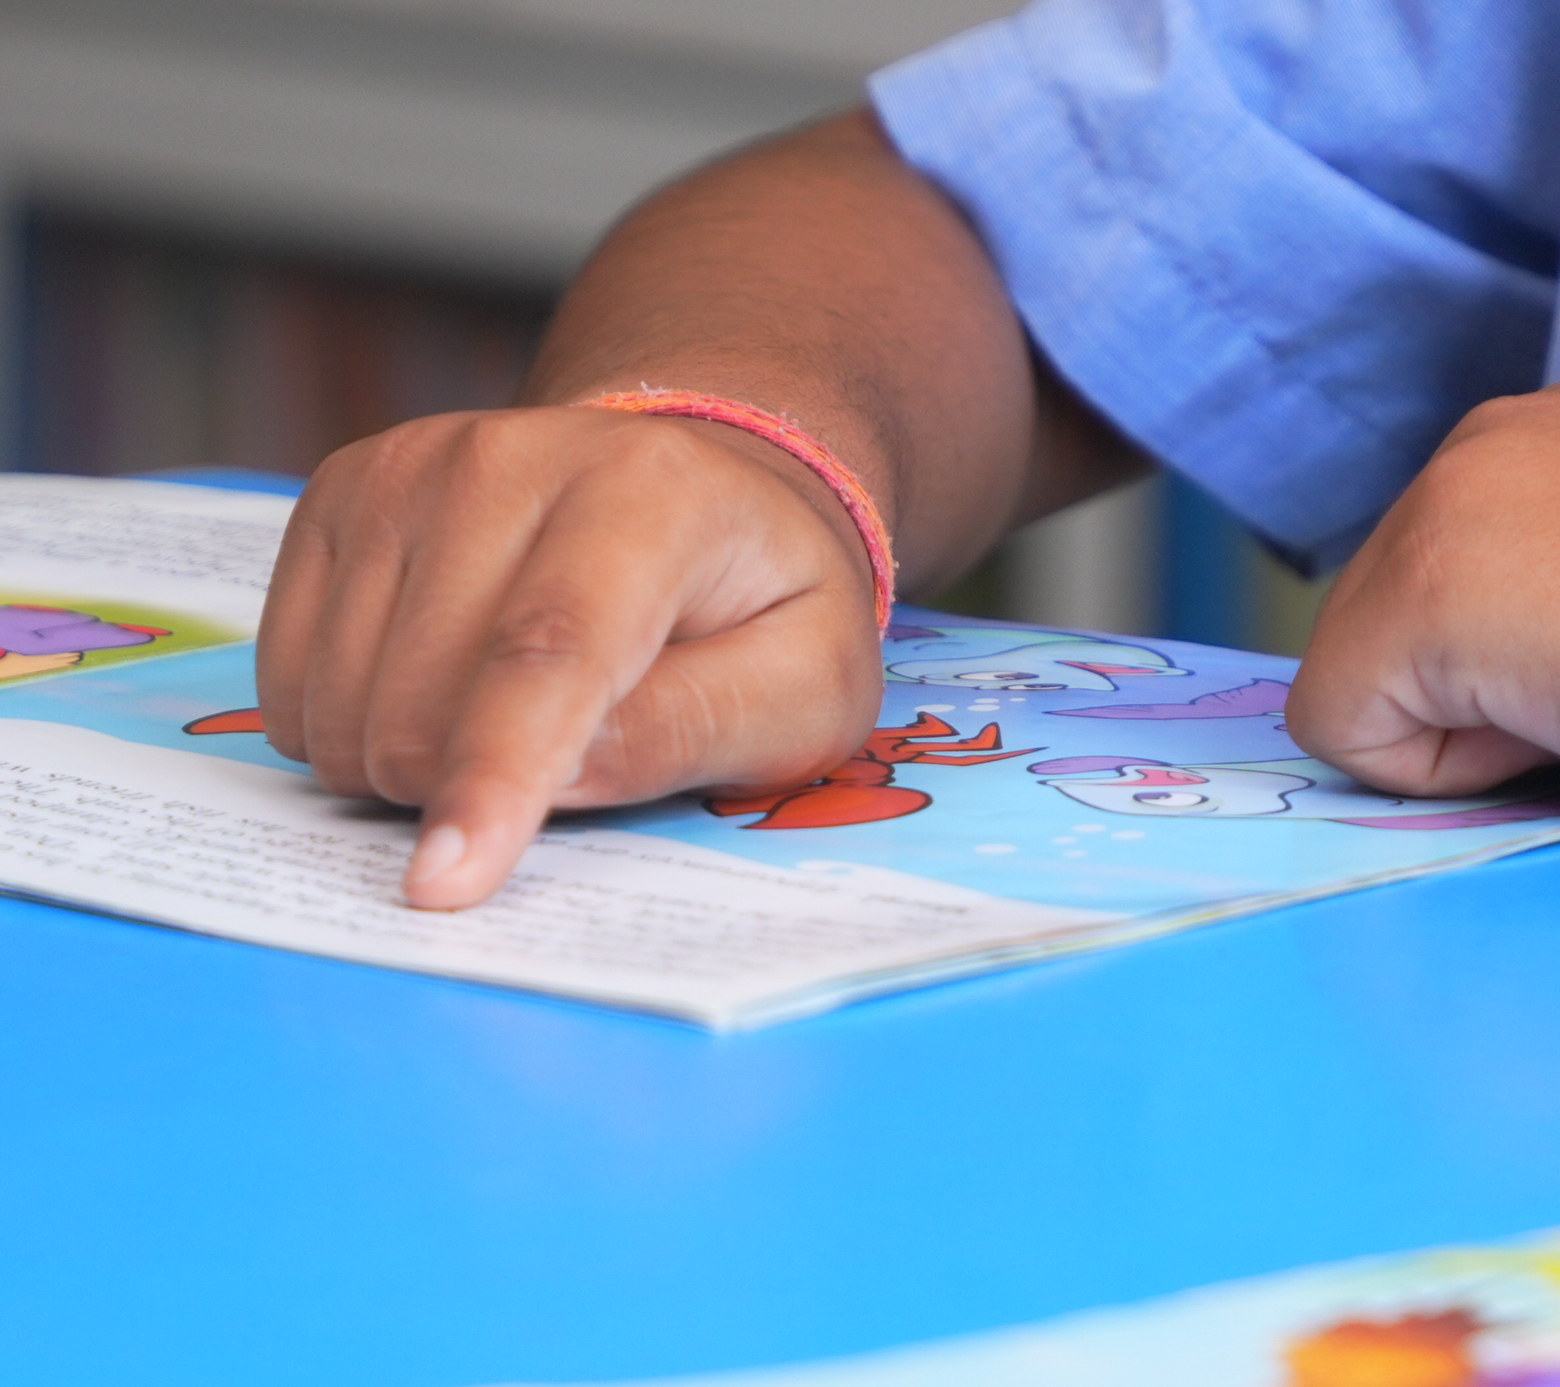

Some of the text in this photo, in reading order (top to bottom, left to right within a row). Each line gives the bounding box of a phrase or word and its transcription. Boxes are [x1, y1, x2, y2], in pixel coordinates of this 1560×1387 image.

[0, 779, 58, 795] The
[42, 772, 154, 800] friends
[162, 800, 226, 817] fish
[234, 817, 287, 832] his
[23, 850, 71, 867] his
